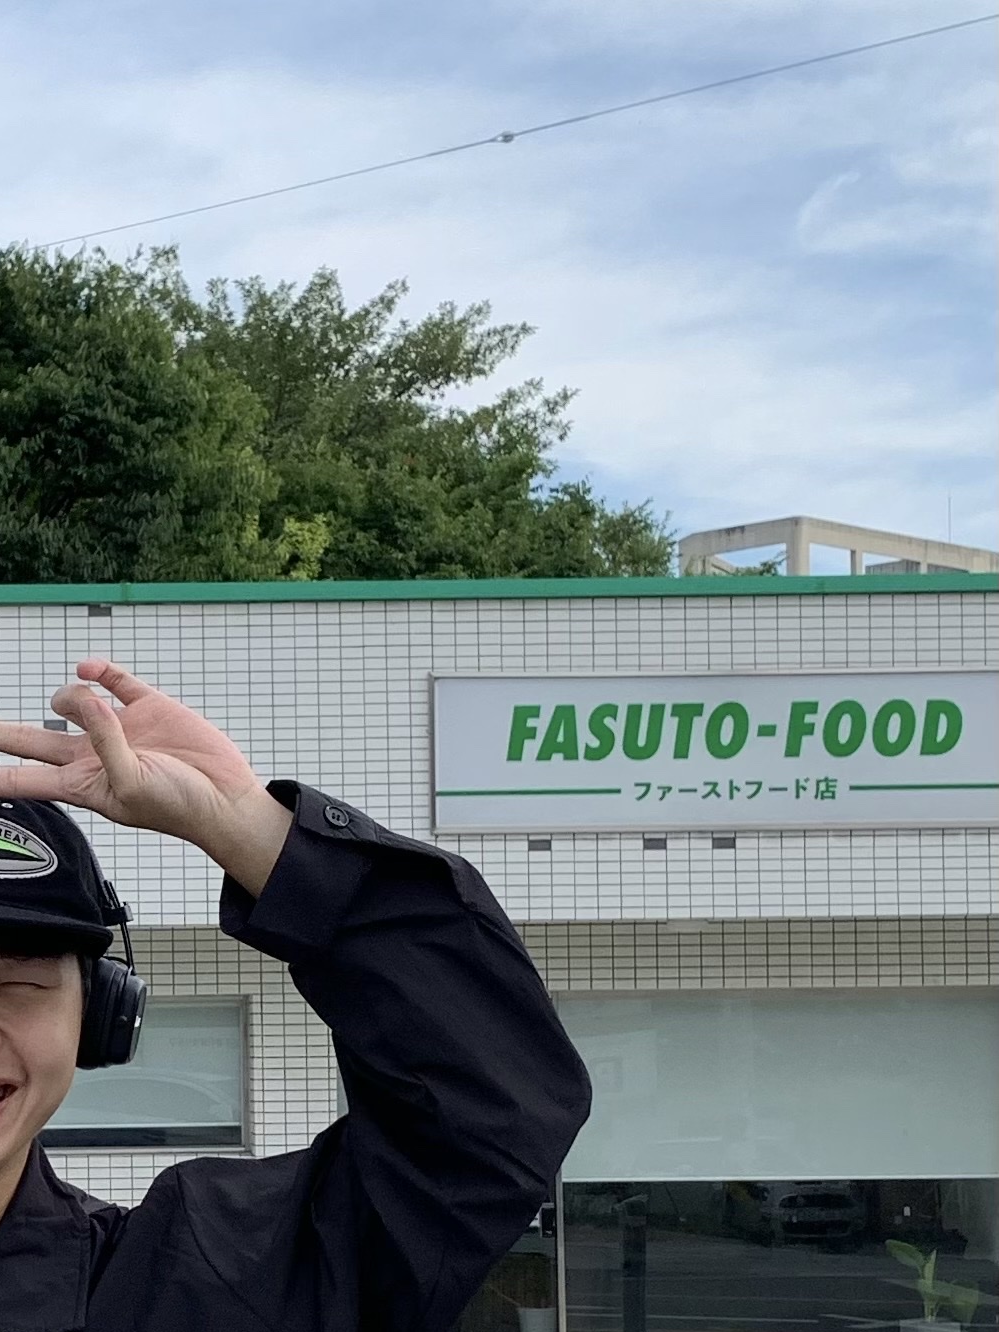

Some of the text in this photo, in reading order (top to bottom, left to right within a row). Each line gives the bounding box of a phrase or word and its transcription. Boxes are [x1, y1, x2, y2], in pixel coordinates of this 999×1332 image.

[506, 699, 963, 762] FASUTO-FOOD
[634, 776, 838, 801] ファーストフード店
